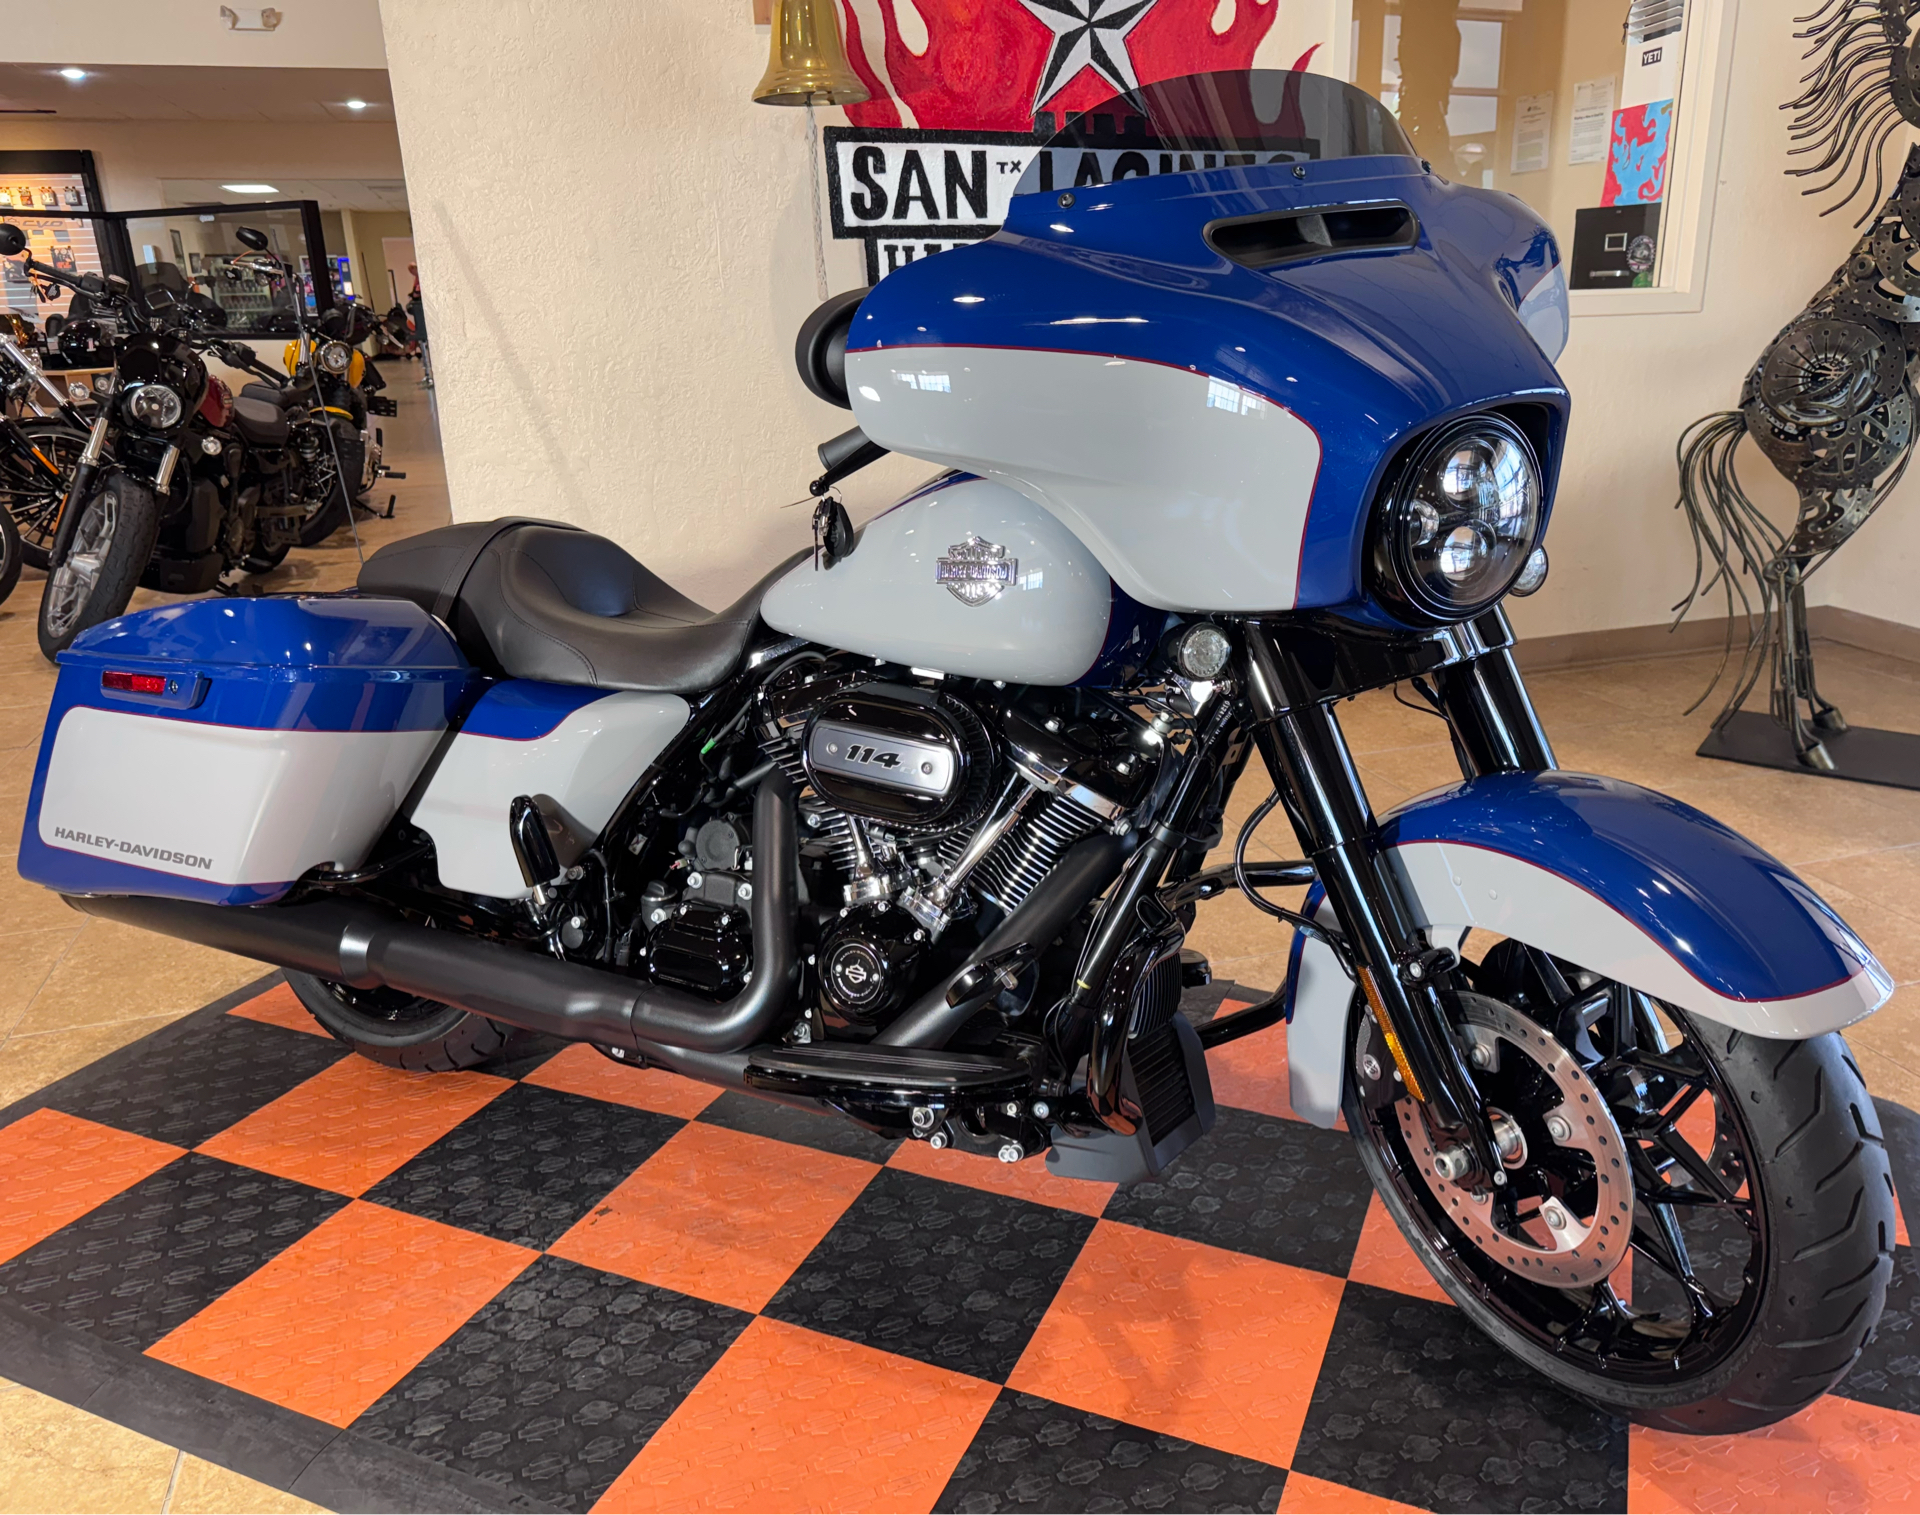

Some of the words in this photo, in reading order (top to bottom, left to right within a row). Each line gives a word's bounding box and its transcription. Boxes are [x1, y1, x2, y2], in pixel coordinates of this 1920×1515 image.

[1643, 49, 1661, 64] YETI
[851, 146, 987, 220] SAN
[996, 160, 1021, 174] TX
[845, 744, 903, 770] 114
[54, 826, 213, 870] HARLEY-DAVIDSON
